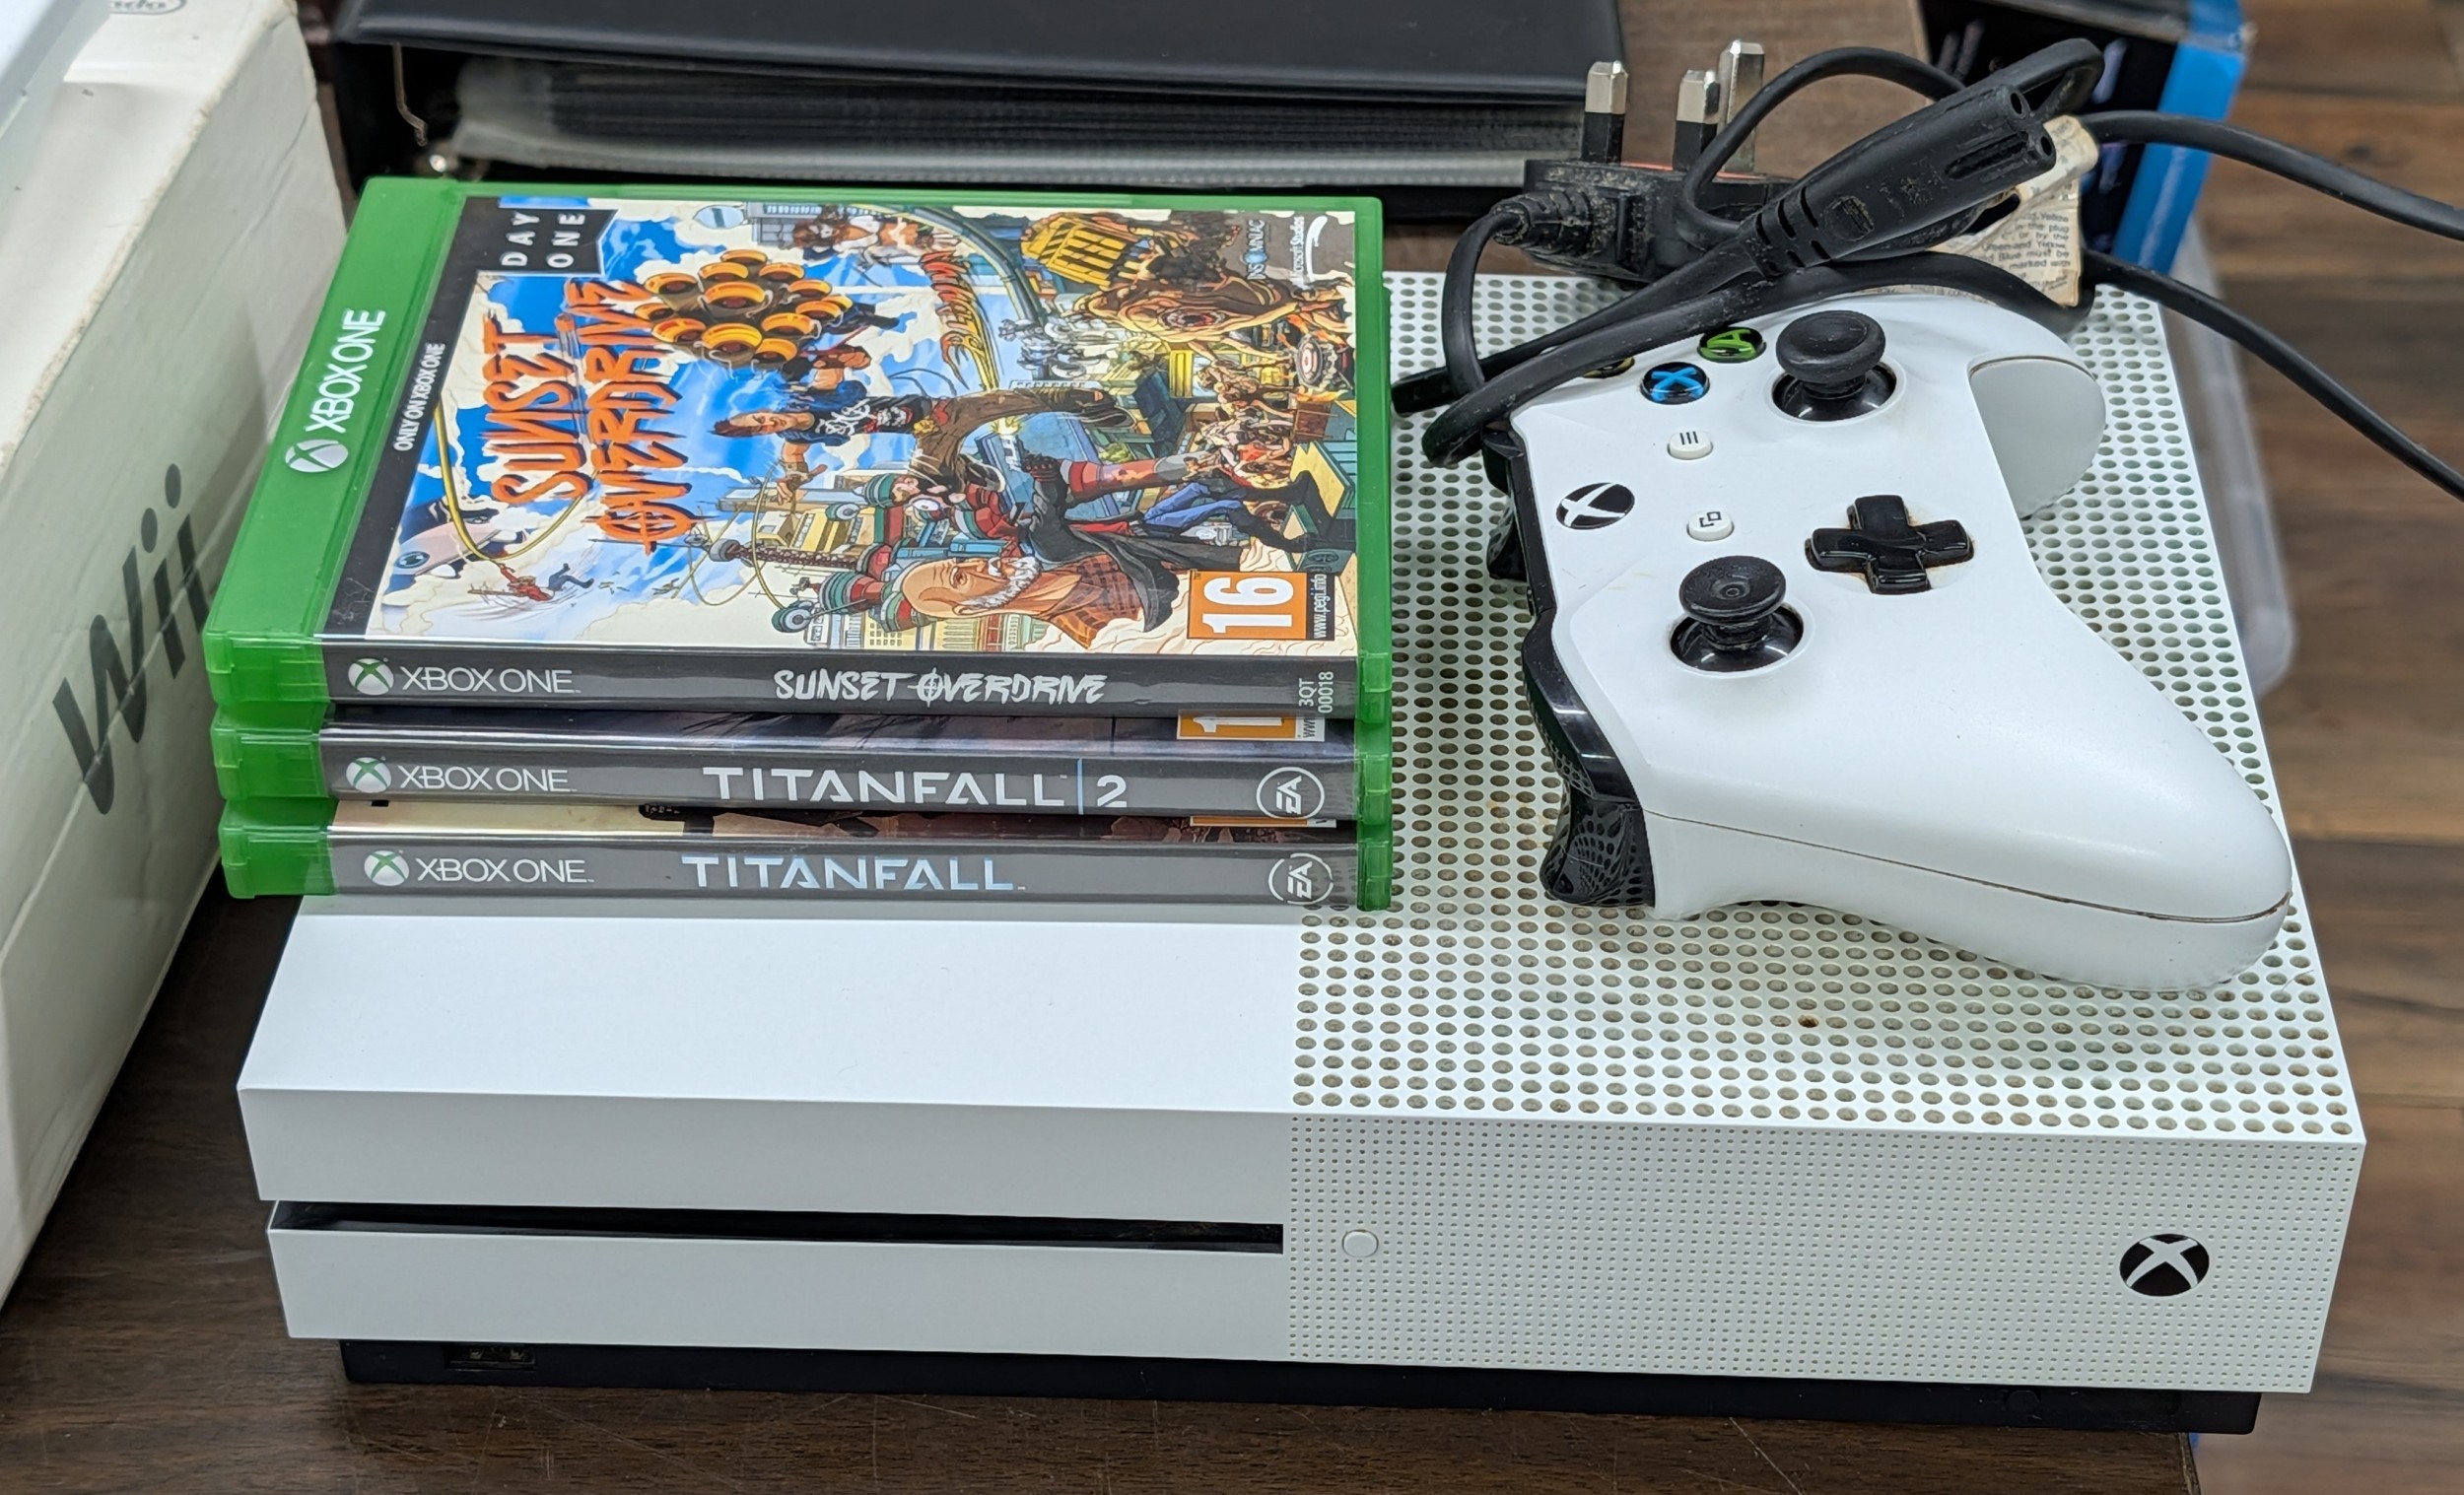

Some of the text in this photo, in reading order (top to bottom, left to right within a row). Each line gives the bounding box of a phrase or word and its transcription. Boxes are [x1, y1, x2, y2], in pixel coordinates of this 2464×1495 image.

[501, 211, 540, 267] DAY
[546, 212, 586, 269] ONE
[2048, 224, 2070, 234] plug
[1998, 251, 2022, 261] Blue
[2025, 248, 2052, 258] must
[2009, 259, 2047, 270] marked
[305, 308, 386, 434] XBOX ONE
[393, 342, 446, 451] ONLY ON XBOX ONE
[478, 308, 593, 506] SUNSET
[555, 276, 719, 556] OVERDRIVE
[1201, 576, 1294, 634] 16
[1313, 573, 1332, 640] www.pegi.info
[52, 462, 213, 815] Wii
[399, 666, 575, 694] XBOX ONE
[774, 667, 1108, 708] SUNSET OVERDRIVE
[1298, 678, 1318, 707] 3QT
[1318, 671, 1335, 714] 00018
[398, 765, 572, 792] XBOX ONE
[702, 766, 1129, 809] TITANFALL 2
[415, 856, 587, 884] XBOX ONE
[681, 854, 1014, 891] TITANFALL
